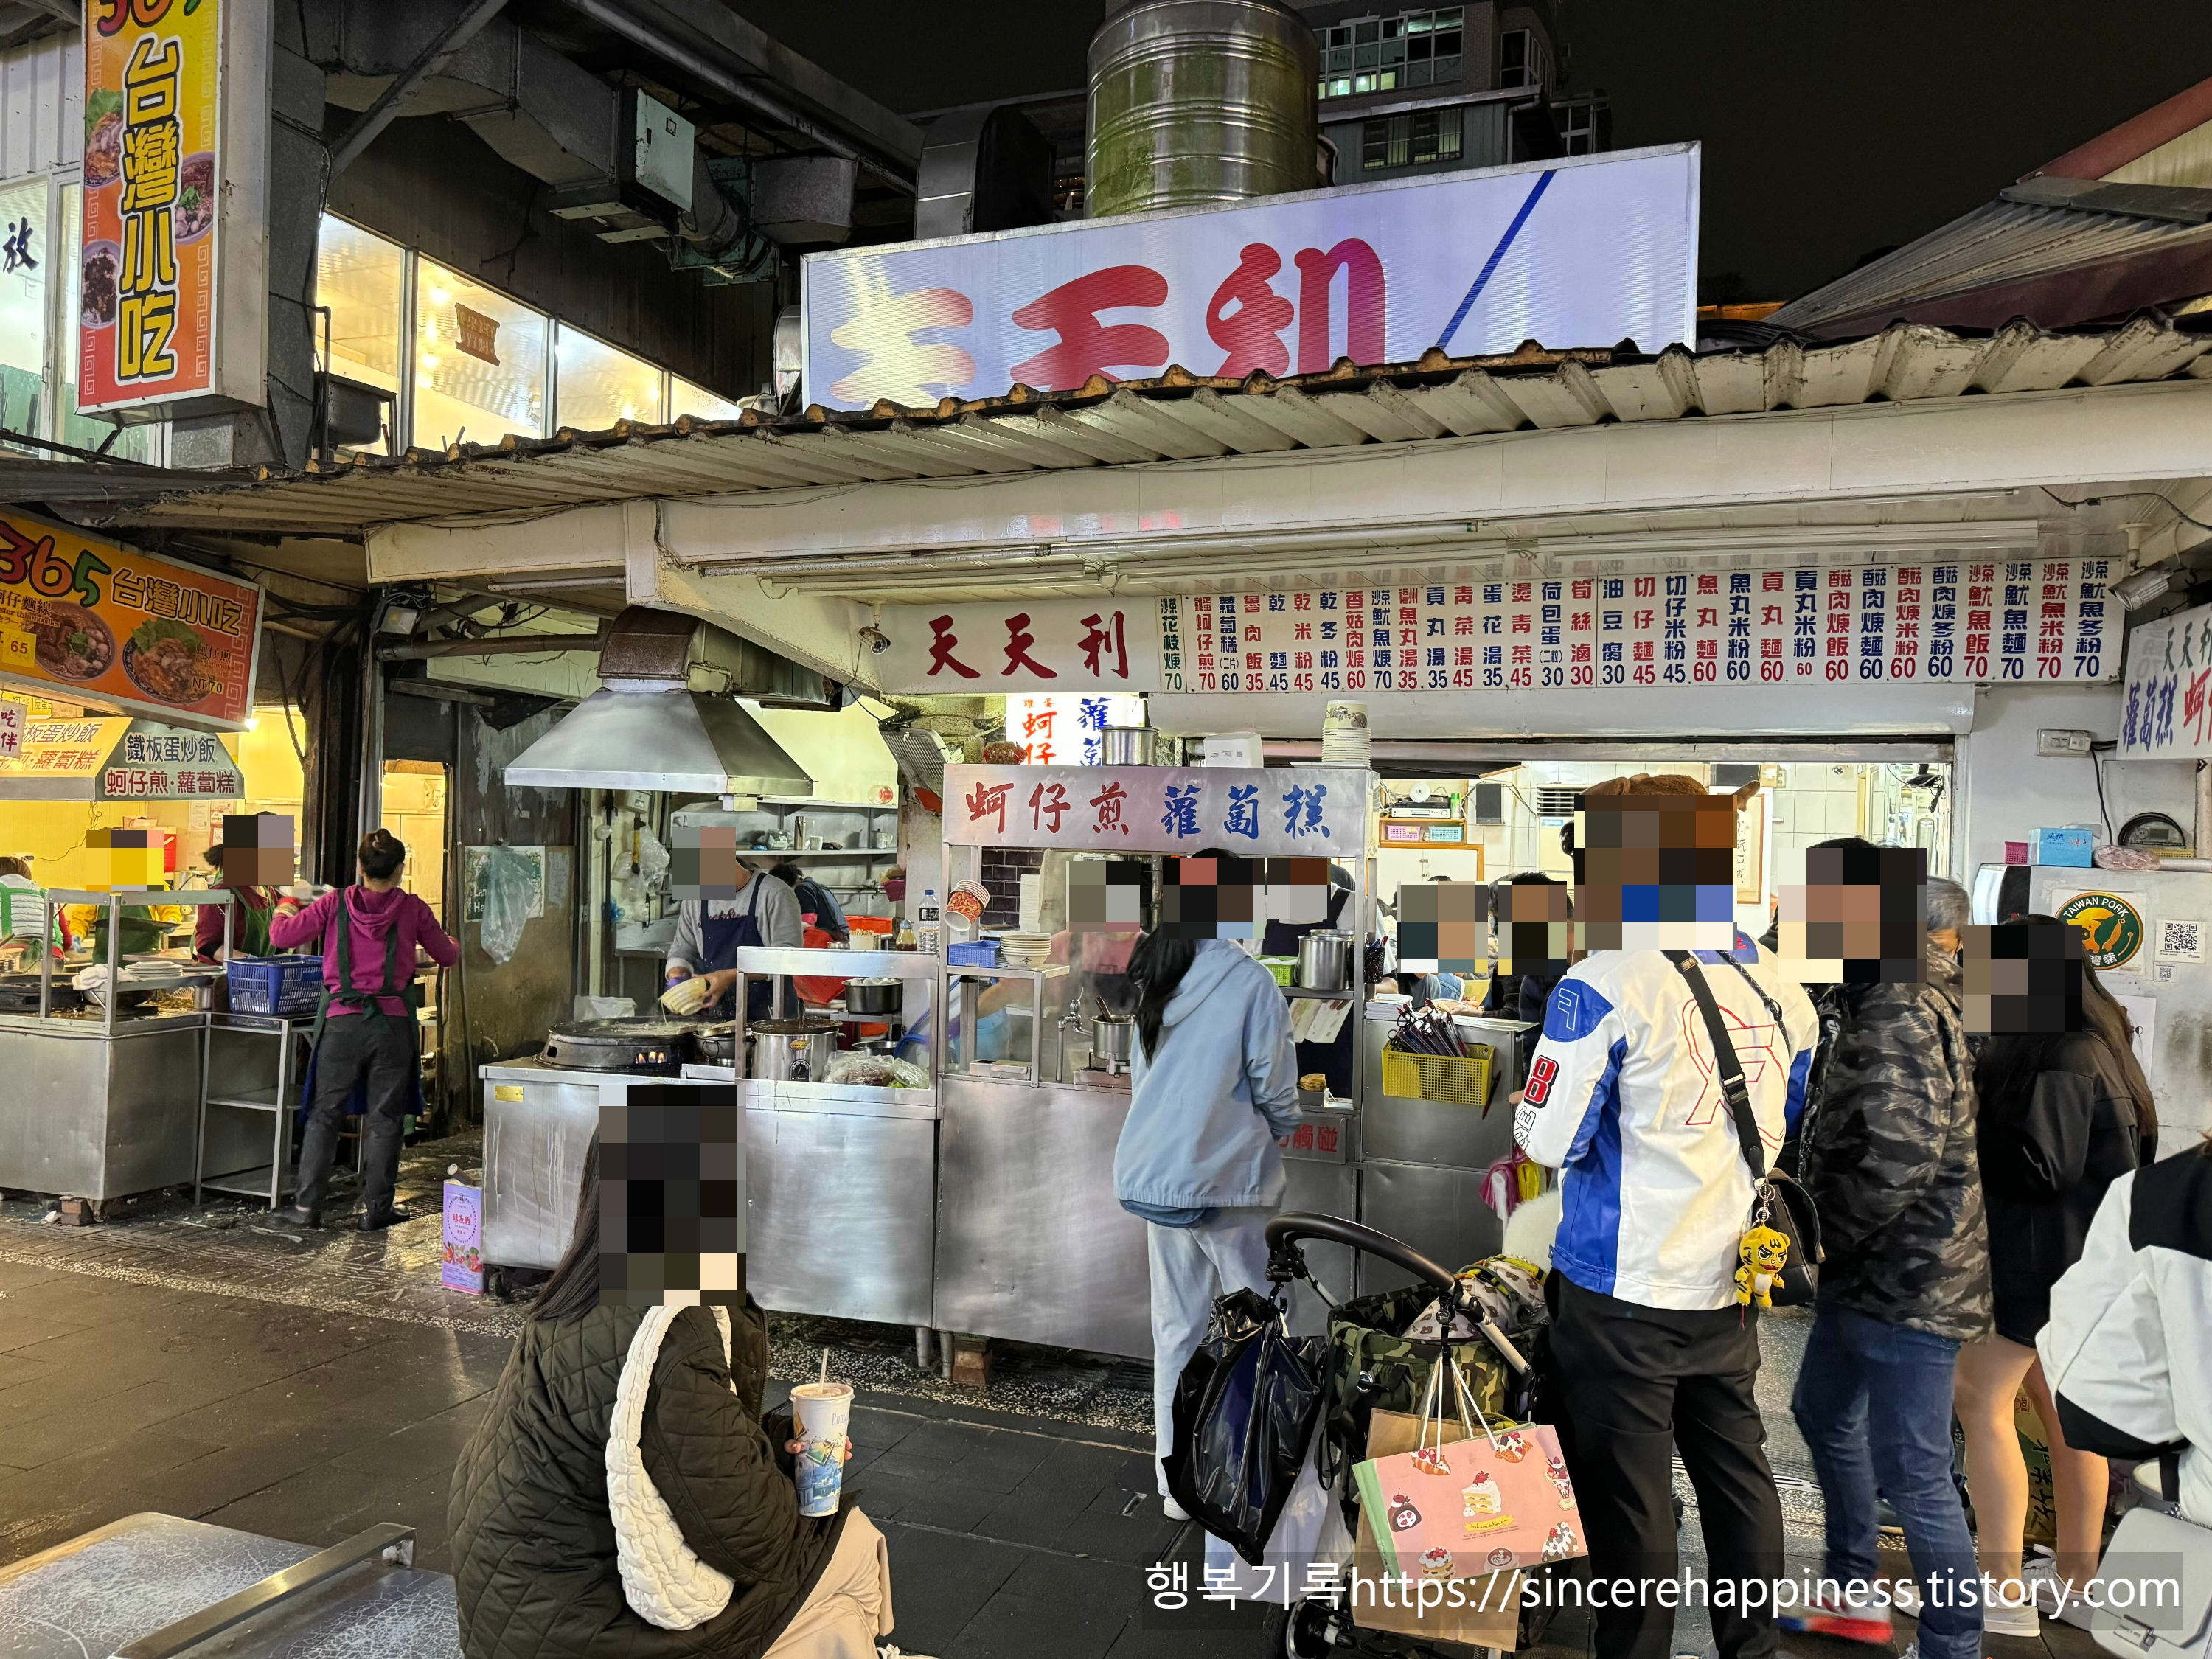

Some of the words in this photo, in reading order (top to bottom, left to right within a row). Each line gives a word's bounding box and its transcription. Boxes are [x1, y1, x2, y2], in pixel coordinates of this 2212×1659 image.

[118, 37, 180, 380] 台灣小吃
[2, 216, 40, 275] 放
[112, 568, 243, 636] 台灣小吃
[11, 641, 28, 654] 65
[927, 611, 1128, 679] 天天利
[1483, 667, 1503, 686] 35
[1510, 667, 1531, 686] 45
[1541, 667, 1564, 686] 30
[1571, 665, 1593, 686] 30
[1602, 664, 1625, 684] 30
[1632, 664, 1655, 684] 45
[1663, 663, 1686, 683] 45
[1694, 661, 1717, 681] 60
[1727, 660, 1750, 681] 60
[1761, 661, 1784, 681] 60
[1797, 662, 1812, 675] 60
[1826, 659, 1848, 681] 60
[1860, 658, 1883, 680] 60
[1891, 658, 1916, 678] 60
[1928, 656, 1952, 677] 60
[1964, 656, 1988, 678] 70
[2000, 658, 2023, 679] 70
[2037, 656, 2061, 678] 70
[2074, 656, 2099, 677] 70
[209, 681, 223, 693] 70
[1165, 672, 1182, 690] 70
[1199, 672, 1216, 690] 70
[1222, 672, 1239, 691] 60
[1246, 673, 1263, 691] 35
[1270, 673, 1288, 691] 45
[1294, 673, 1313, 691] 45
[1321, 671, 1340, 689] 45
[1346, 670, 1365, 689] 60
[1373, 670, 1392, 689] 70
[1398, 670, 1418, 689] 35
[1428, 669, 1447, 689] 35
[1453, 668, 1473, 687] 45
[24, 723, 102, 742] 板蛋炒飯
[126, 736, 215, 763] 鐵板蛋炒飯
[965, 782, 1130, 835] 蚵仔煎
[1160, 783, 1331, 840] 蘿蔔糕
[2063, 897, 2099, 919] TAIWAN
[2101, 897, 2129, 918] PORK
[1523, 1054, 1559, 1109] 8
